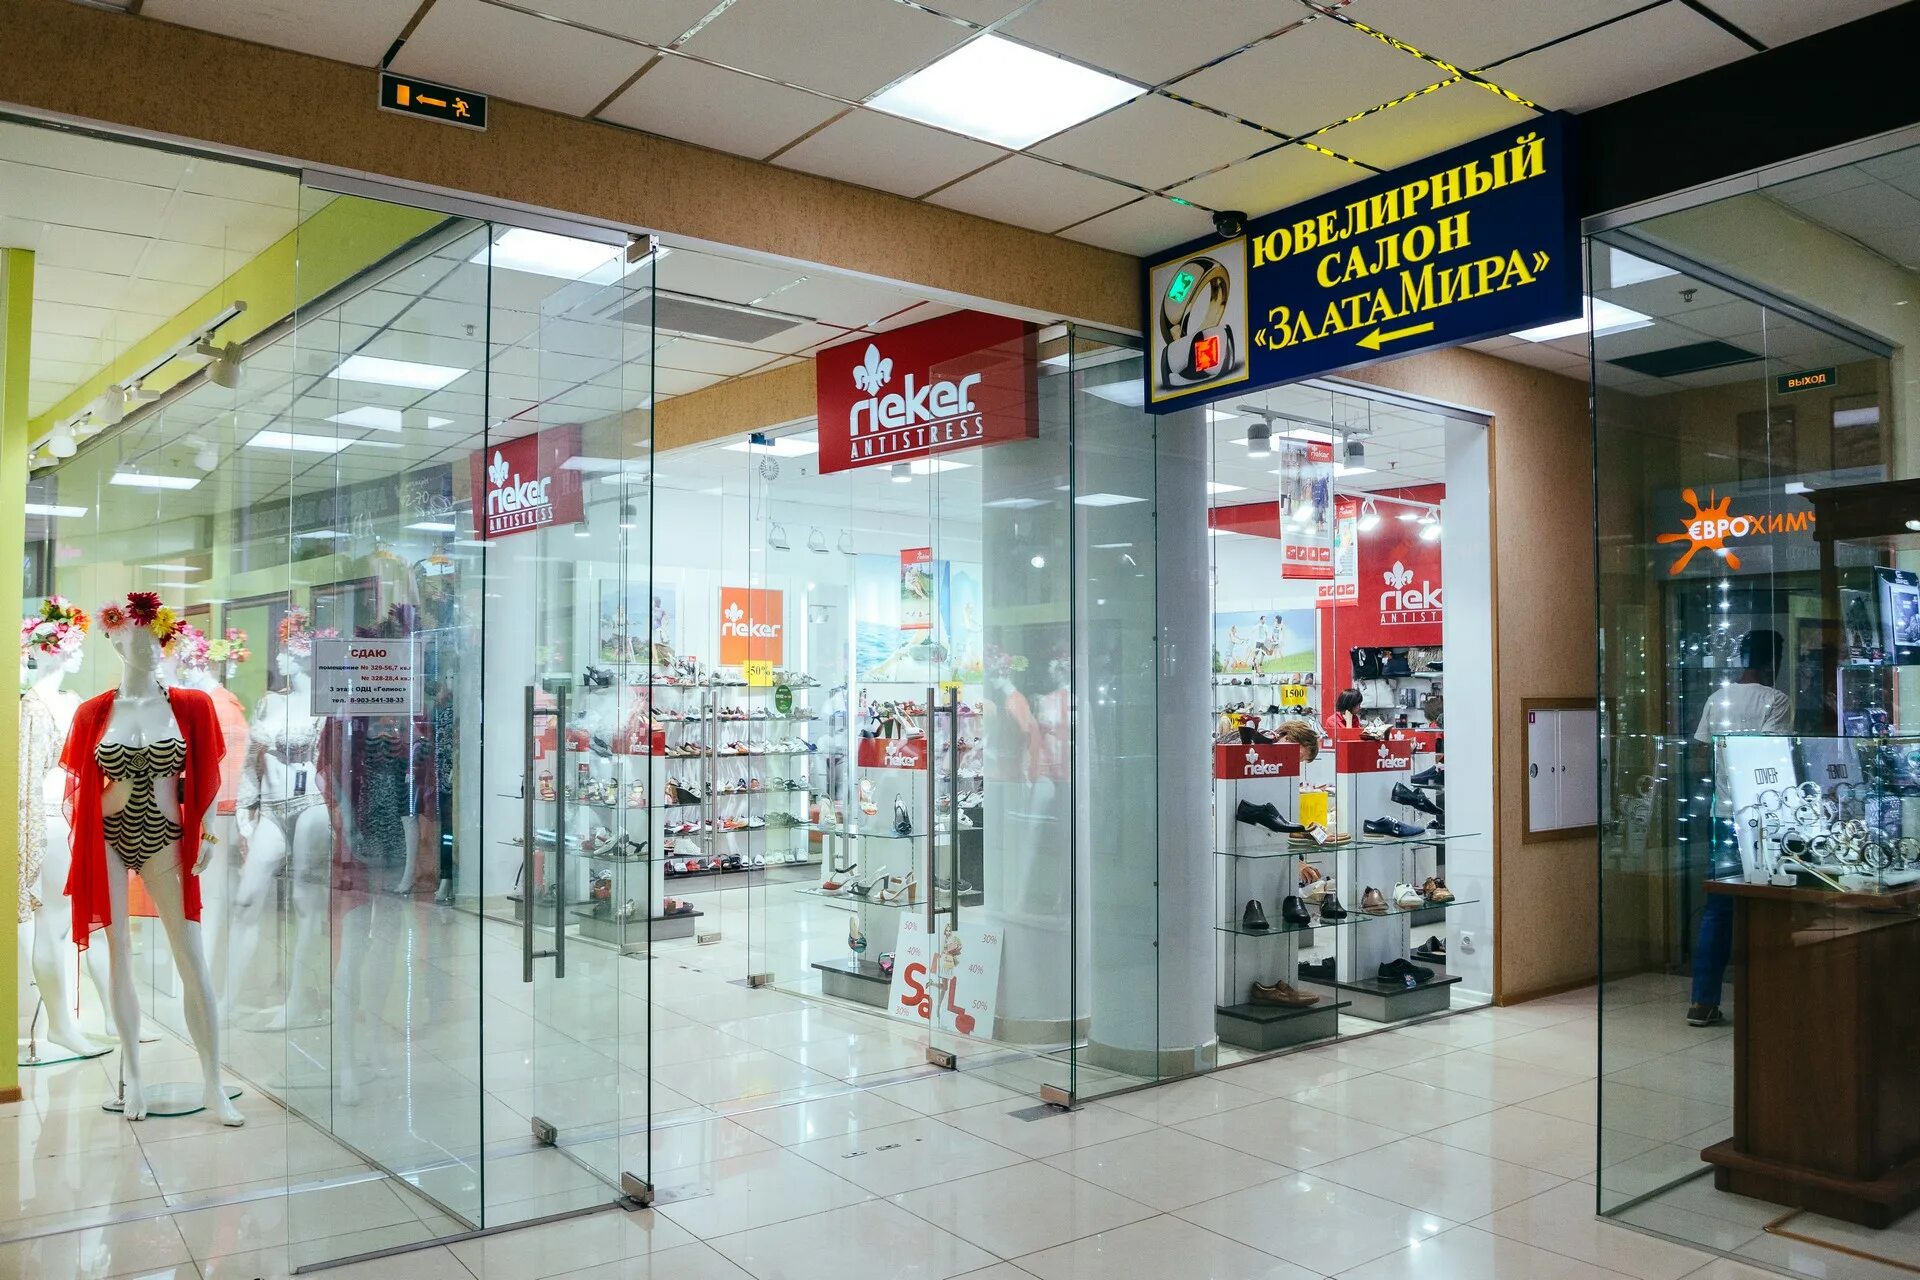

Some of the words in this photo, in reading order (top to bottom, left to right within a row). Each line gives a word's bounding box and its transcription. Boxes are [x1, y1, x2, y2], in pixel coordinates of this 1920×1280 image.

[1252, 131, 1547, 268] ЮВЕЛИРНЫЙ
[1316, 211, 1472, 288] САЛОН
[1788, 374, 1826, 388] ВЫХОД
[849, 373, 982, 436] rieker
[851, 417, 983, 458] ANTISTRESS
[488, 473, 551, 515] rieker
[490, 507, 554, 531] ANTISTRESS
[722, 617, 782, 638] rieker
[351, 649, 387, 658] СДАЮ
[1284, 689, 1304, 698] 1500
[885, 752, 919, 767] rieker
[1244, 759, 1283, 776] rieker
[1376, 754, 1409, 770] rieker
[904, 920, 918, 931] 50%
[981, 934, 998, 945] 30%
[968, 964, 984, 975] 40%
[972, 999, 988, 1011] 50%
